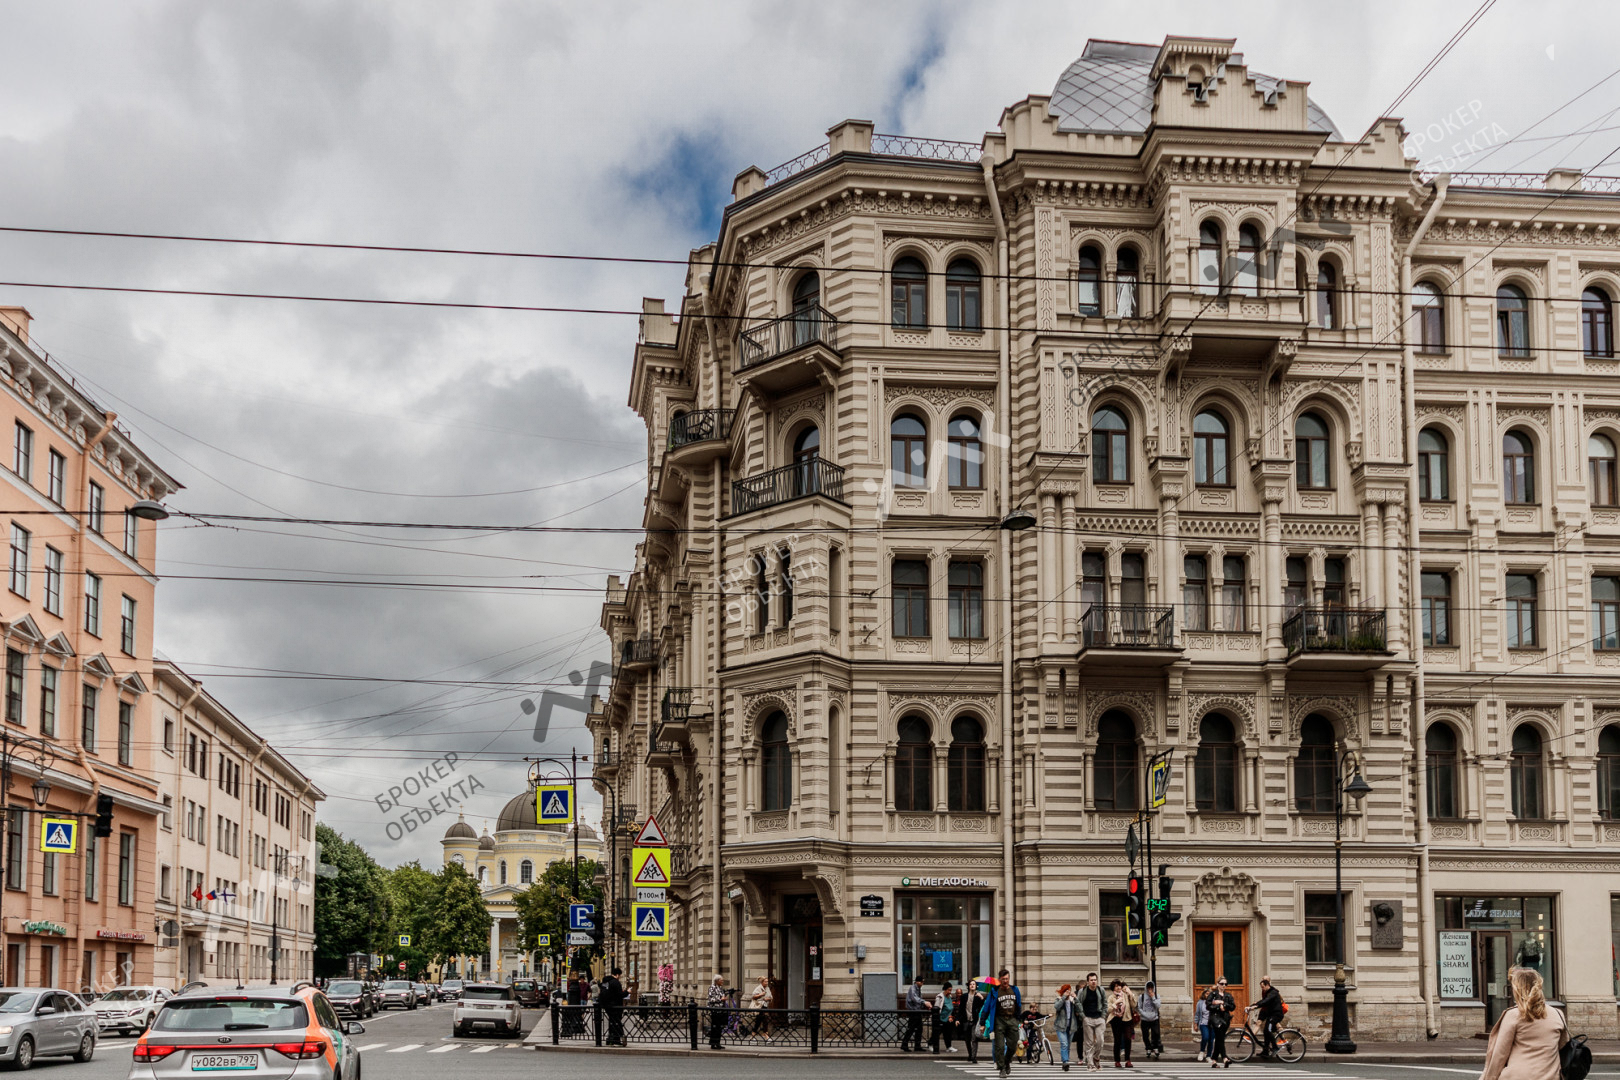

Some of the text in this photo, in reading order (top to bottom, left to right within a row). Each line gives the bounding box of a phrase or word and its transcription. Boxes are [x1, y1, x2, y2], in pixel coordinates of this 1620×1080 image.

[1464, 909, 1522, 917] LADY SHARM
[1442, 976, 1471, 984] размеры
[1443, 985, 1472, 994] 48-76
[238, 1055, 255, 1063] 797
